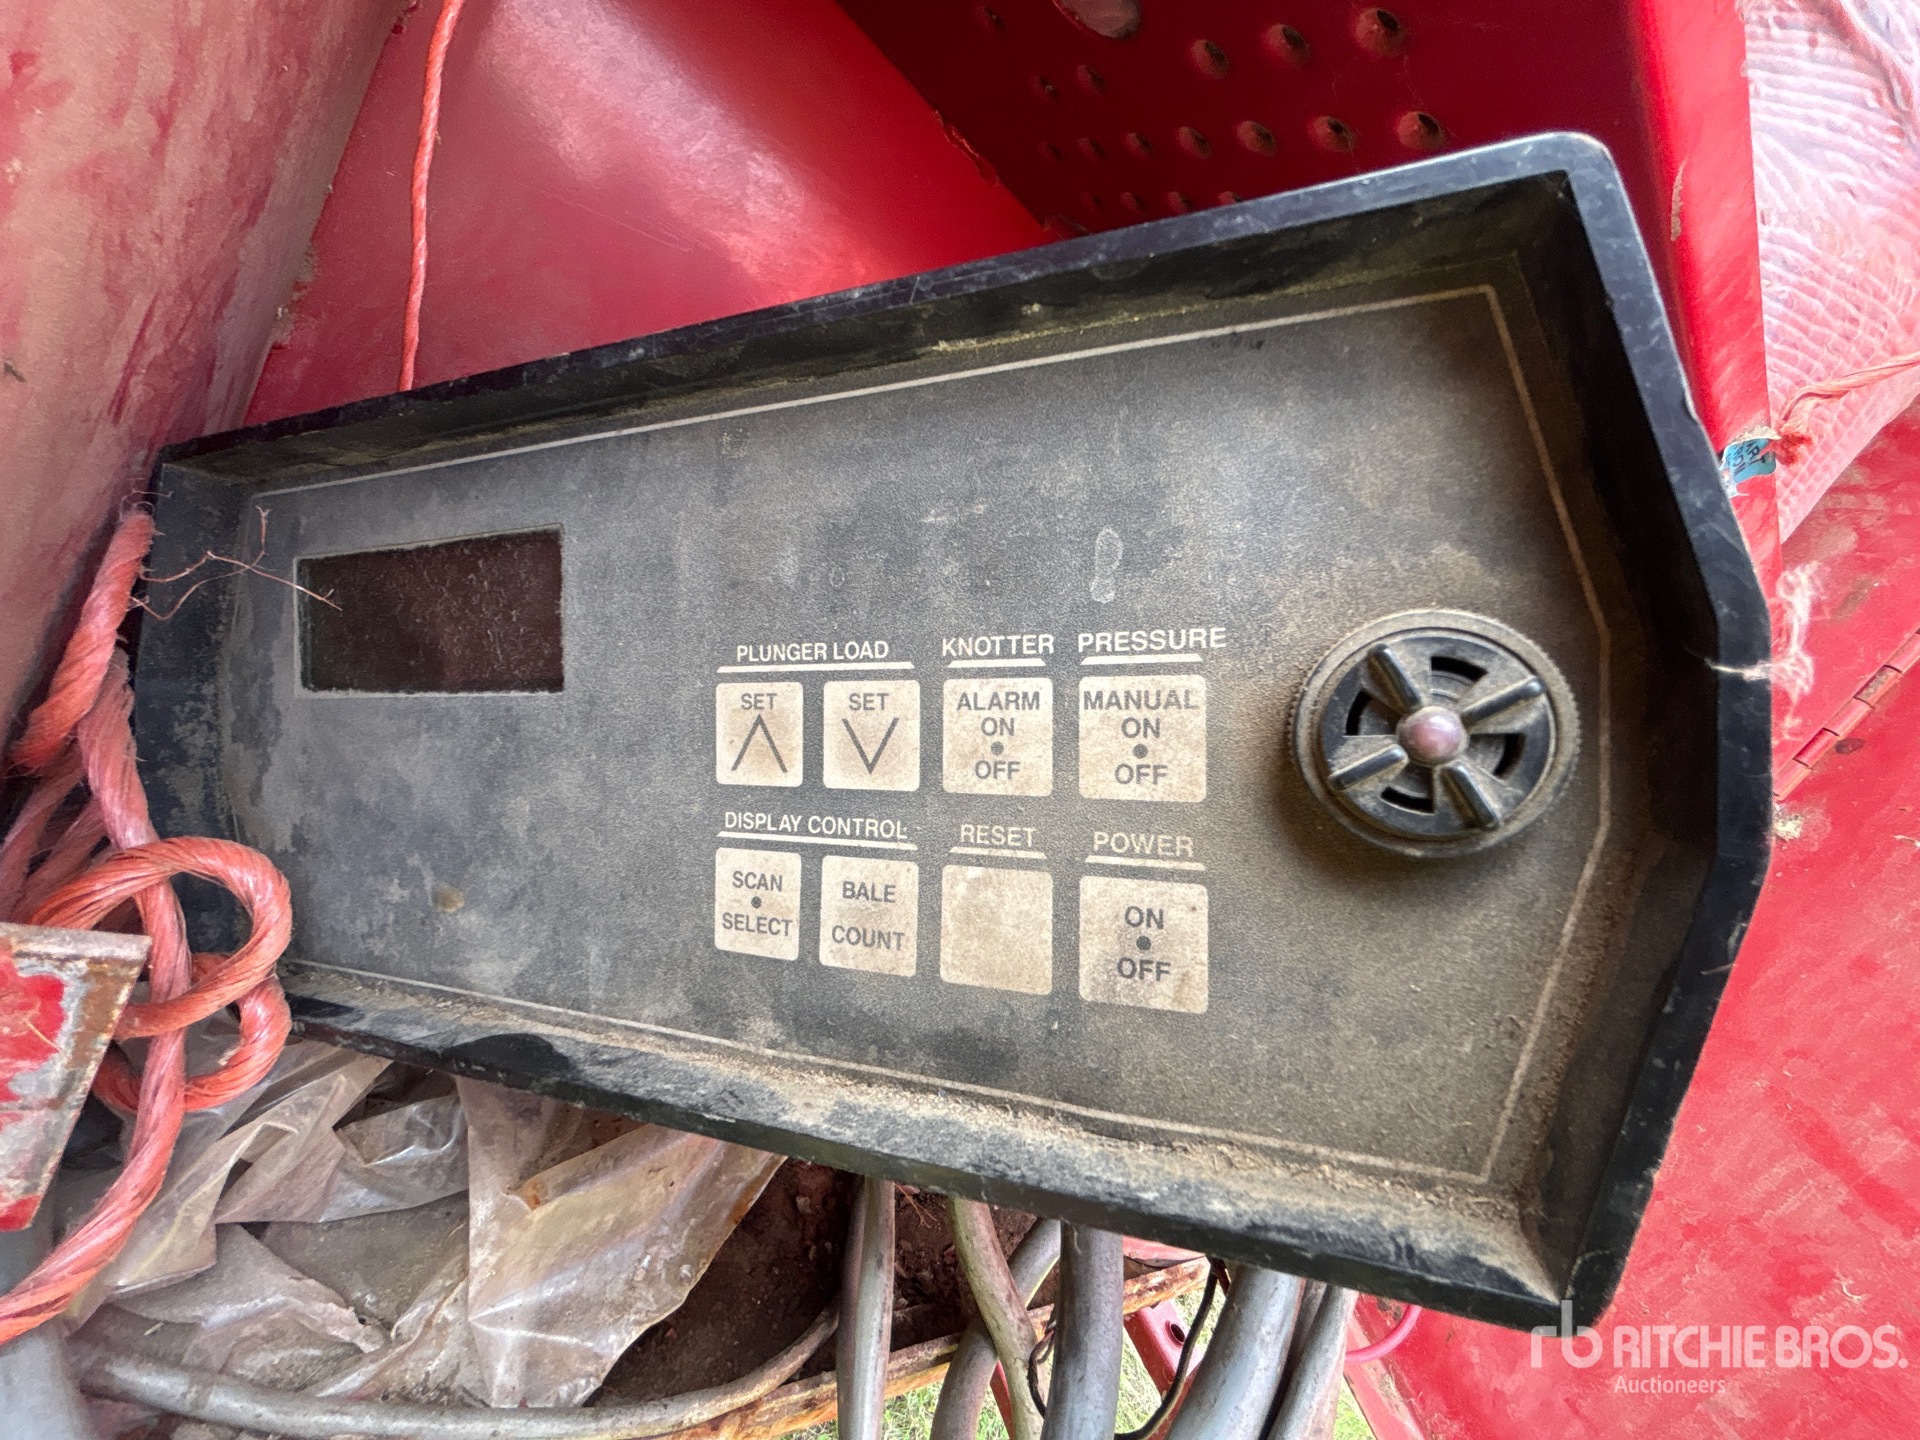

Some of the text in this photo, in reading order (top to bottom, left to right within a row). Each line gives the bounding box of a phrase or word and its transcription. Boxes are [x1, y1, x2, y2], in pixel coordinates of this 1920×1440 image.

[941, 634, 1055, 657] KNOTTER
[1077, 627, 1227, 653] PRESSURE
[736, 640, 889, 663] PLUNGER LOAD
[740, 692, 777, 710] SET
[848, 692, 889, 711] SET
[956, 691, 1041, 711] ALARM
[1082, 689, 1200, 710] MANUAL
[980, 718, 1015, 737] ON
[1121, 717, 1161, 739] ON
[974, 760, 1021, 780] OFF
[1113, 764, 1169, 785] OFF
[724, 811, 908, 840] DISPLAY CONTROL
[960, 824, 1036, 847] RESET
[1093, 831, 1194, 857] POWER
[732, 871, 783, 893] SCAN
[842, 881, 896, 903] BALE
[721, 913, 793, 937] SELECT
[1124, 905, 1165, 929] ON
[831, 926, 905, 951] COUNT
[1116, 957, 1172, 981] OFF
